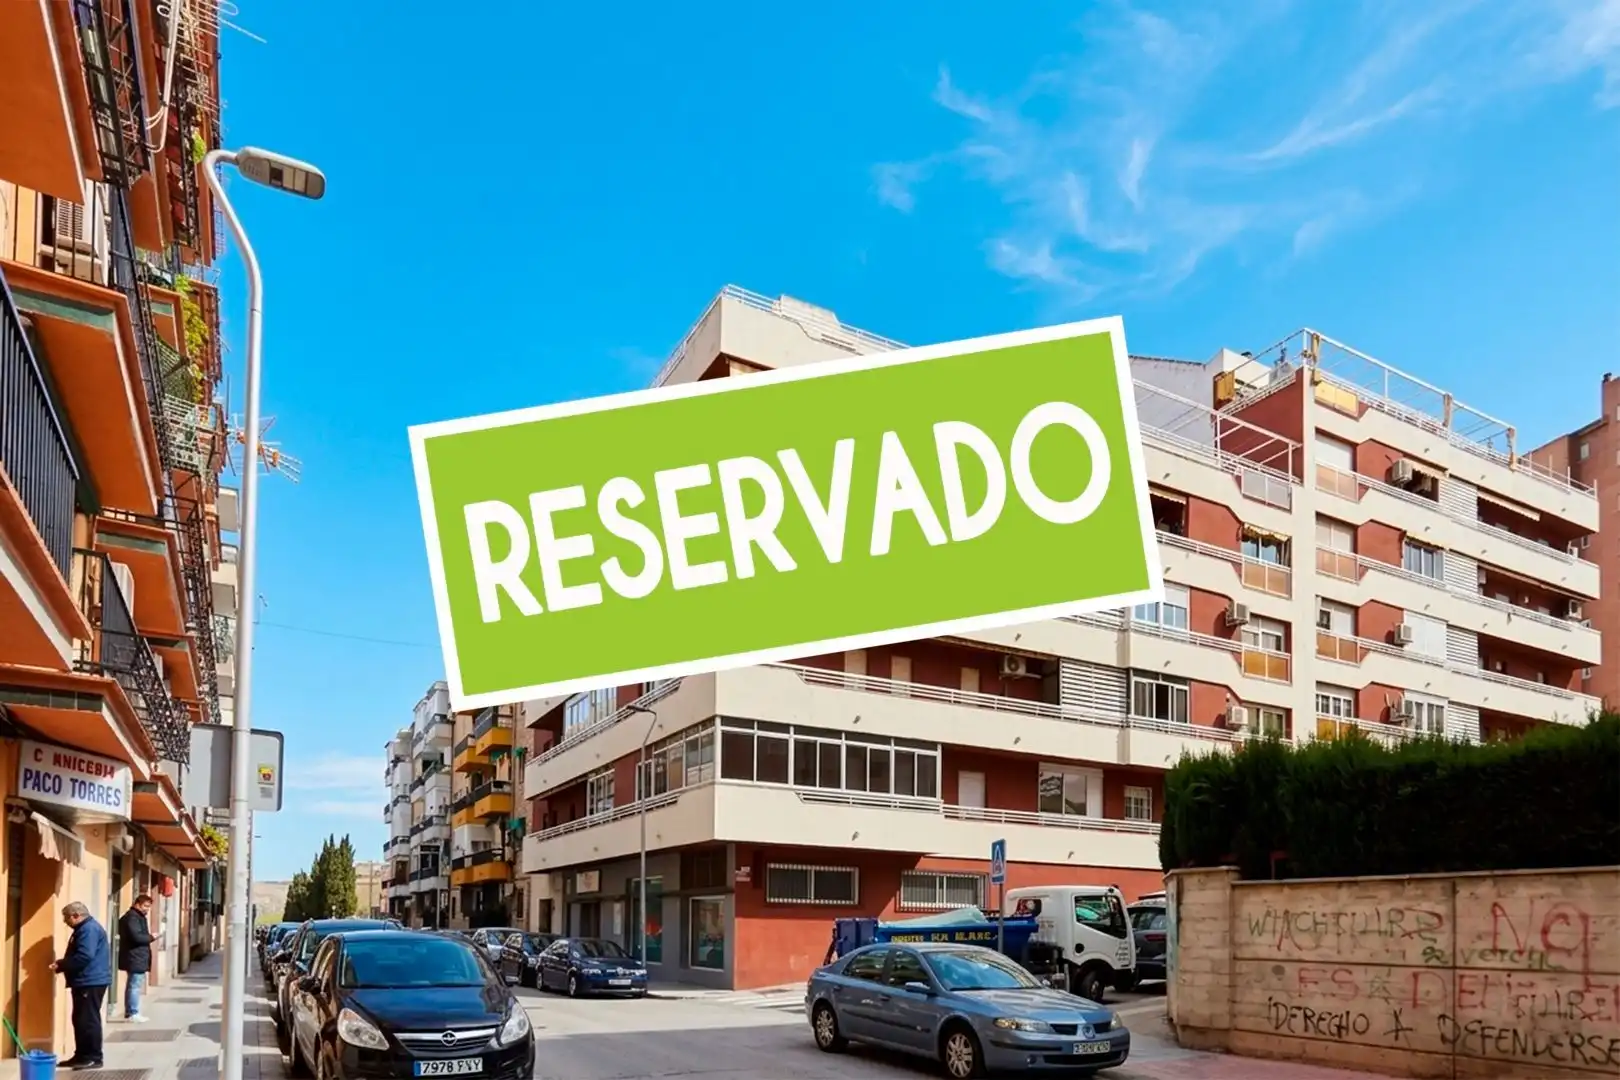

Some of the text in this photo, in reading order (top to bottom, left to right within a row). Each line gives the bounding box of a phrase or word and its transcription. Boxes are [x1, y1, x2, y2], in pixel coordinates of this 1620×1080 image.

[22, 766, 122, 808] PACO TORRES
[422, 1060, 454, 1074] 7978
